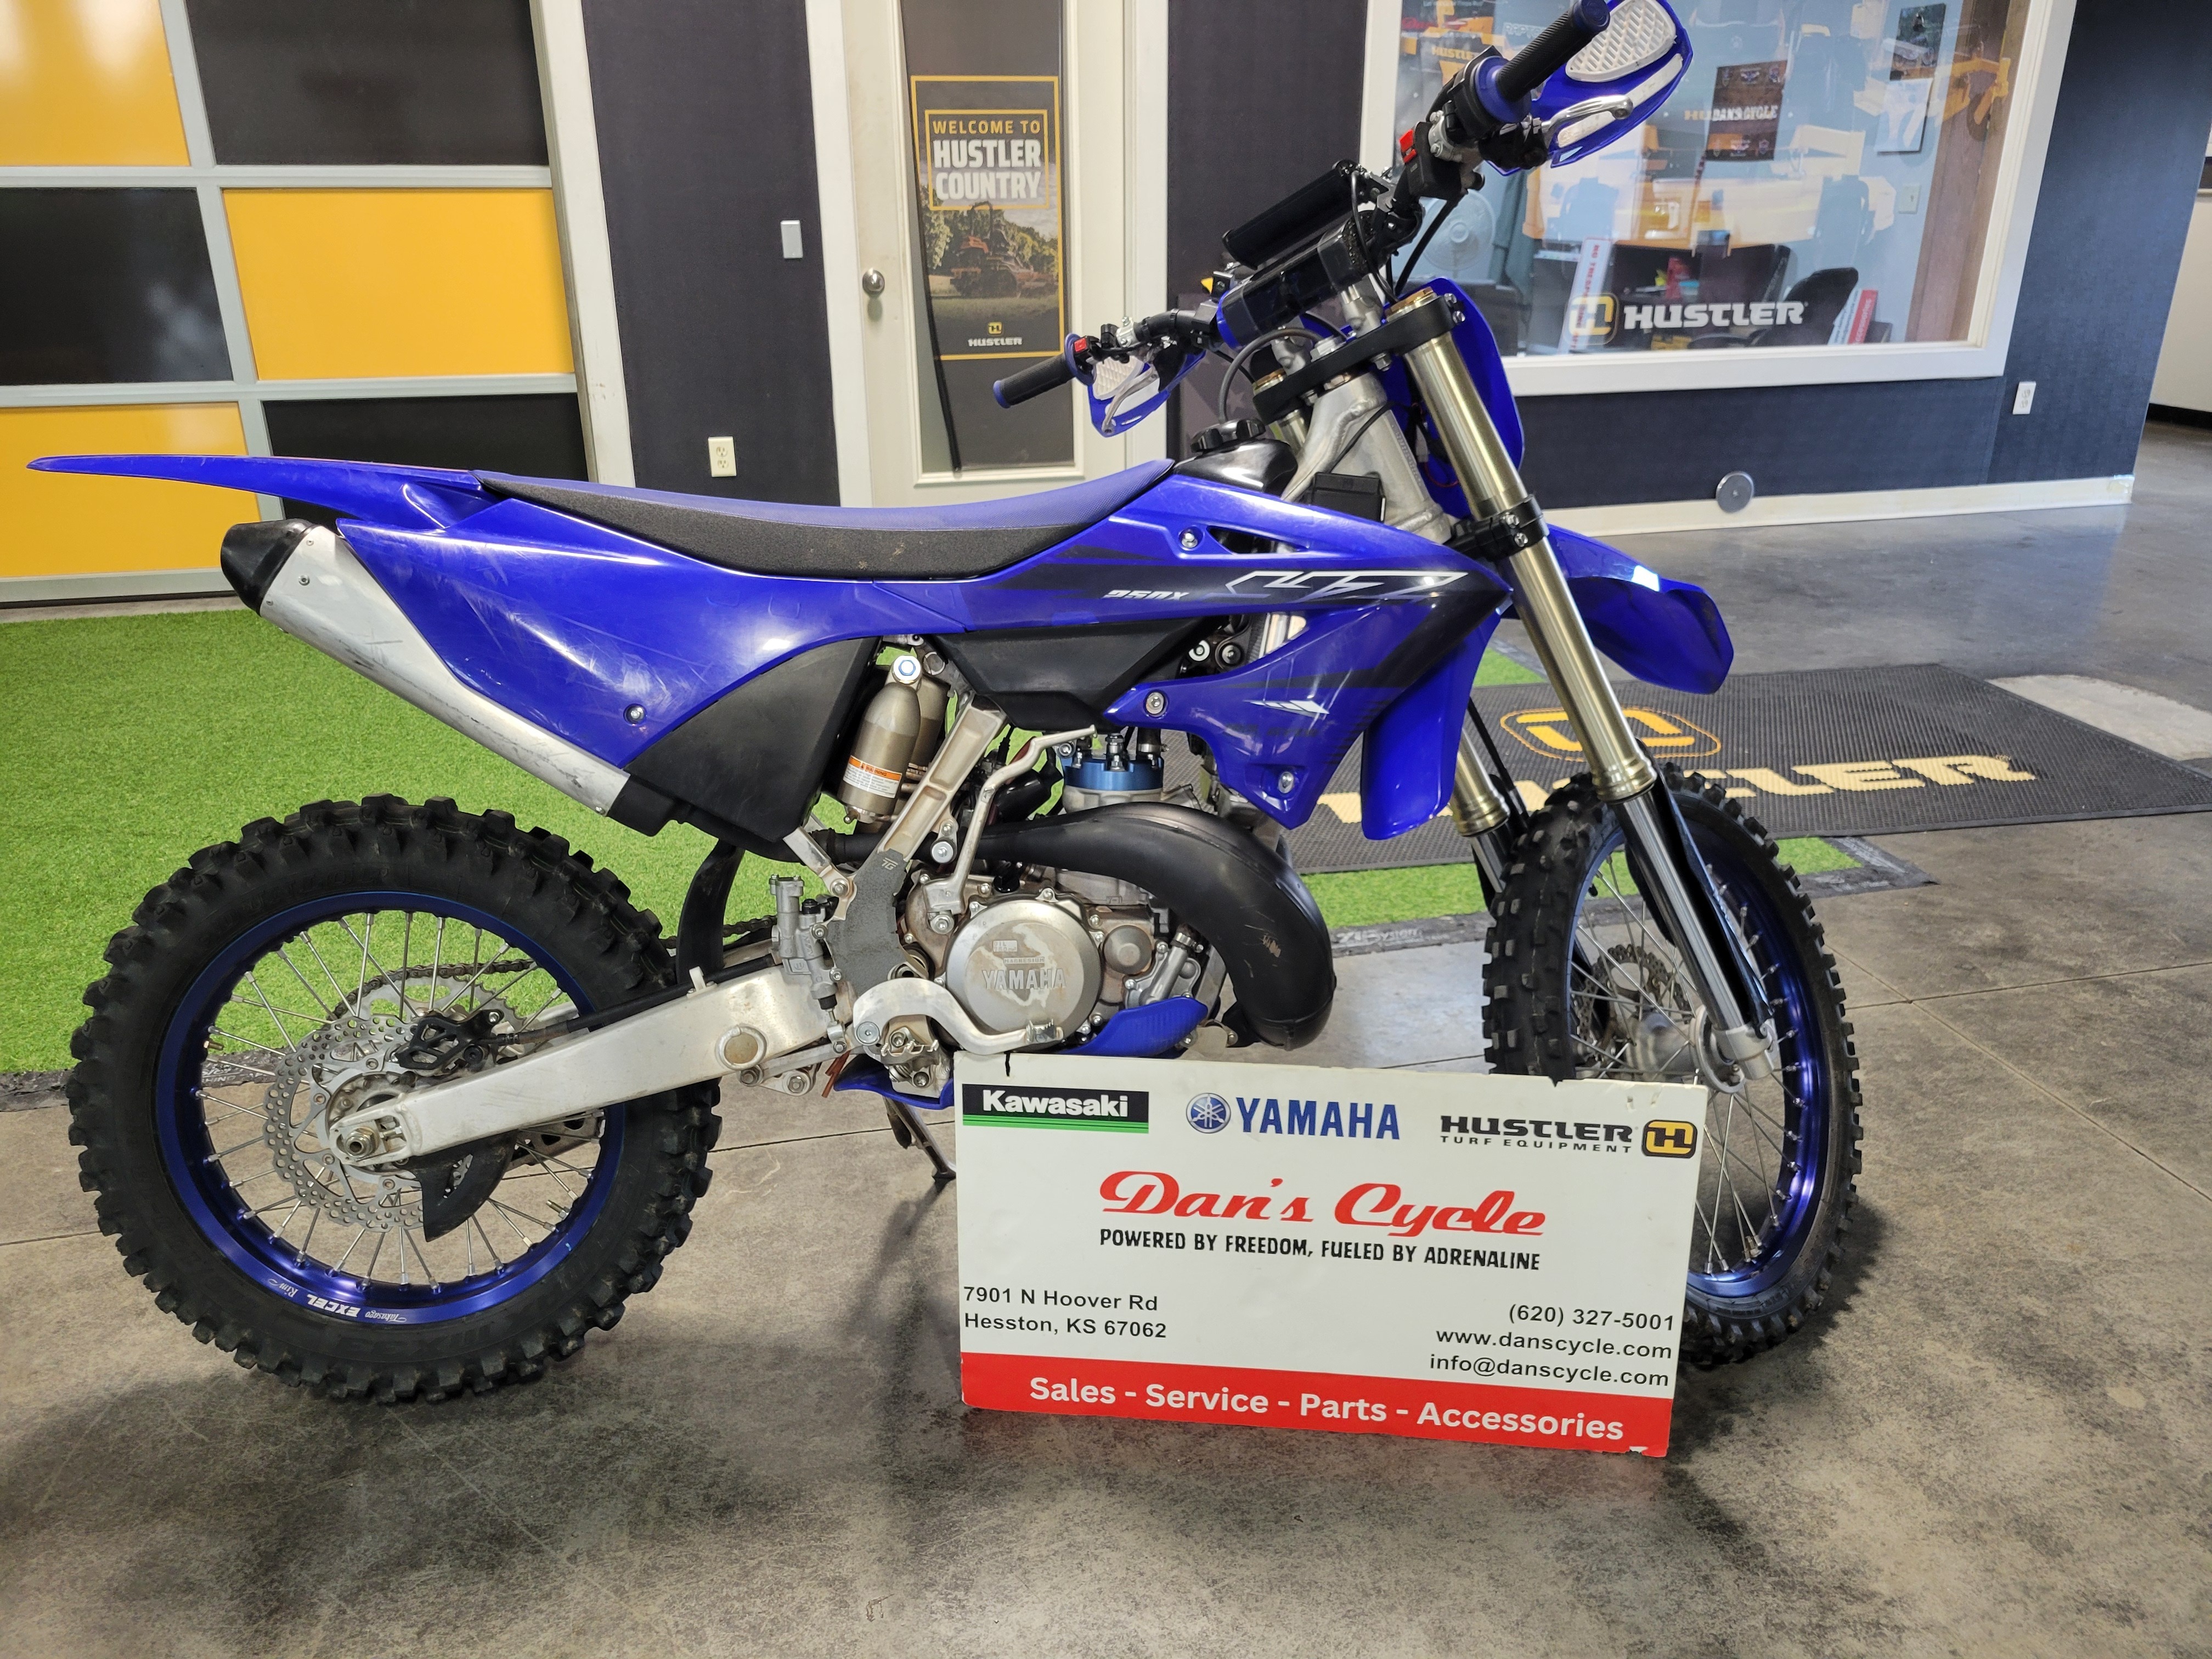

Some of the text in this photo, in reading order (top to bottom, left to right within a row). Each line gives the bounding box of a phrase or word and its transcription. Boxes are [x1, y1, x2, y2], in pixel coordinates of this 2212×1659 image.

[1431, 44, 1474, 60] HUSTLE
[933, 120, 1040, 134] WELCOME TO
[933, 140, 1041, 168] HUSTLER
[935, 172, 1041, 200] COUNTRY
[1624, 301, 1804, 330] HUSTLER
[968, 337, 1022, 346] HUSTLER
[982, 969, 1066, 989] YAMAHA
[983, 1090, 1127, 1116] Kawasaki
[1236, 1097, 1400, 1139] YAMAHA
[1441, 1116, 1633, 1142] HUSTLER
[1441, 1136, 1630, 1153] TURF EQUIPMENT
[1100, 1171, 1545, 1237] Dan's Cycle
[1101, 1229, 1539, 1270] POWERED BY FREEDOM, FUELED BY ADRENALINE
[268, 1278, 407, 1323] Takasago EXCEL Rim
[963, 1286, 1156, 1310] 7901 N Hoover Rd
[966, 1313, 1166, 1338] Hesston, KS 67062
[1510, 1304, 1672, 1330] (620) 327-5001
[1436, 1329, 1672, 1359] www.danscycle.com
[1430, 1355, 1669, 1386] info@danscycle.com
[1030, 1378, 1115, 1403] Sales
[1146, 1384, 1268, 1413] Service
[1301, 1393, 1386, 1421] Parts
[1417, 1403, 1623, 1440] Accessories
